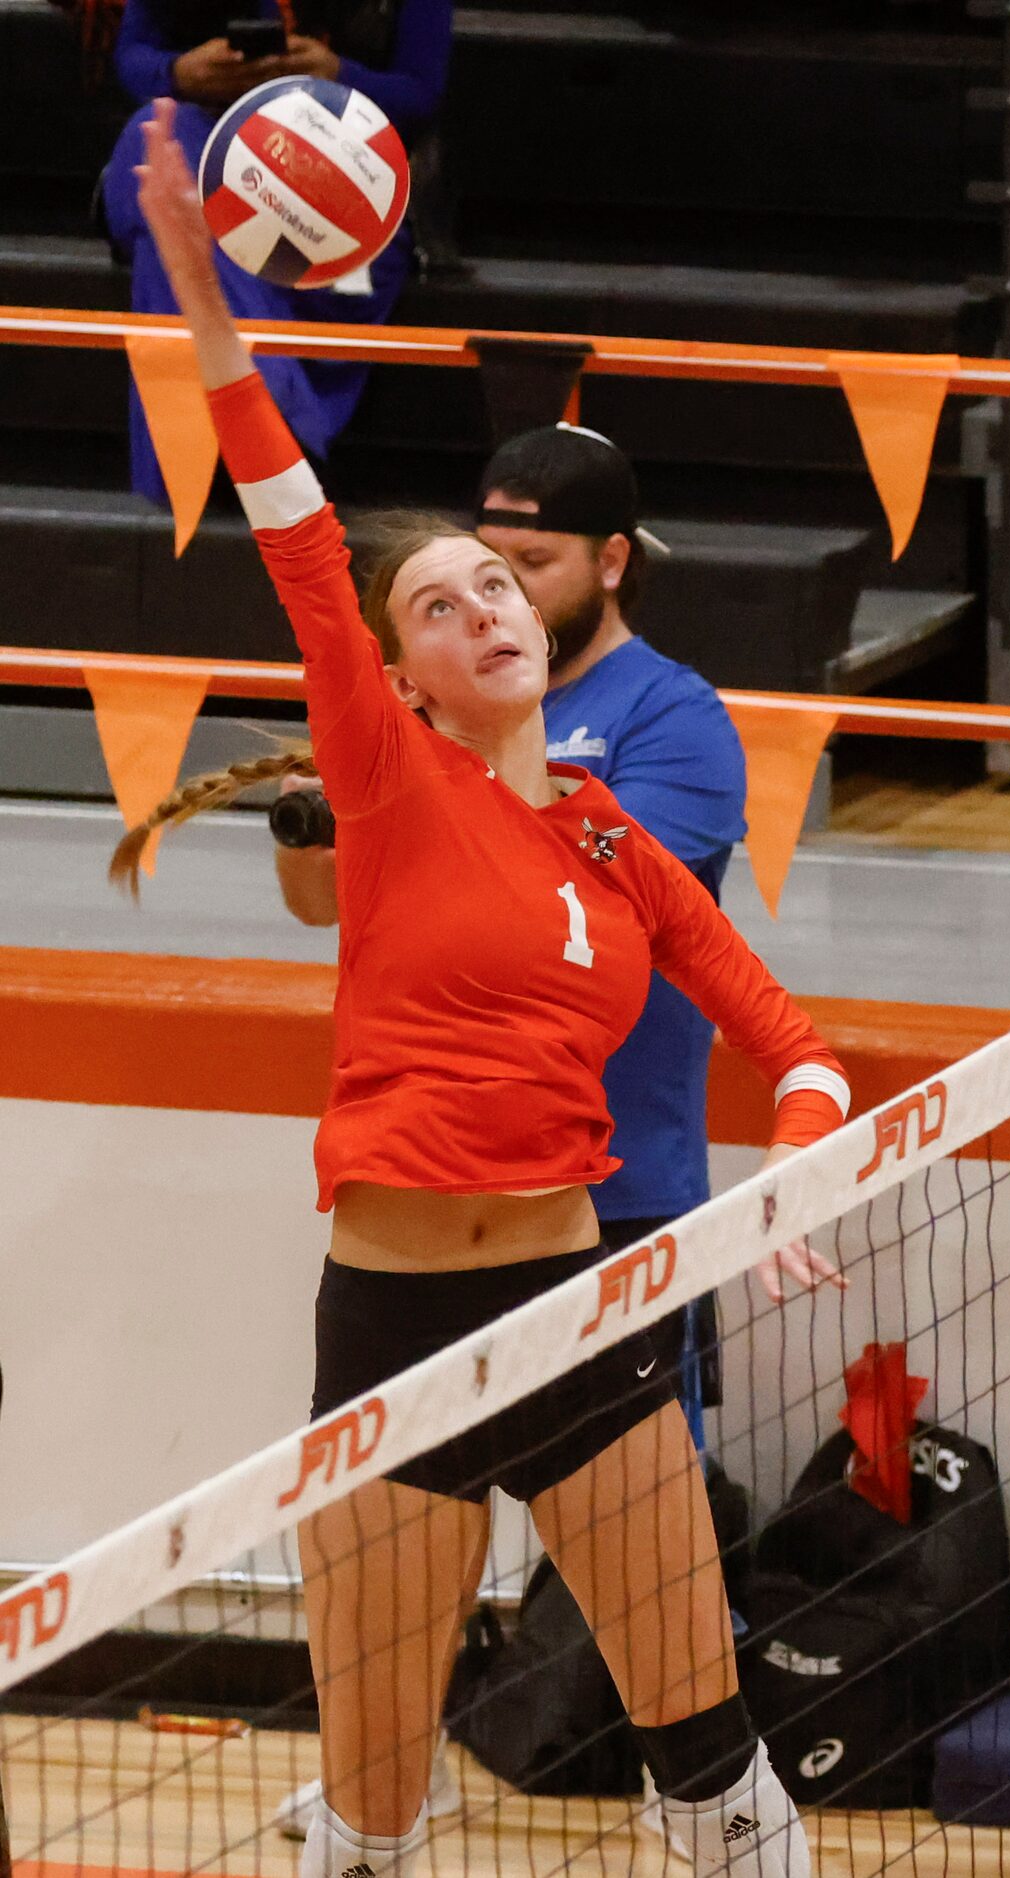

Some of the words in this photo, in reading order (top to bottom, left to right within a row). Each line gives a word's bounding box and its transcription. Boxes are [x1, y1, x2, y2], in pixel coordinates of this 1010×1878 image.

[557, 881, 594, 968] 1
[909, 1437, 963, 1493] SICS
[722, 1820, 761, 1844] adidas
